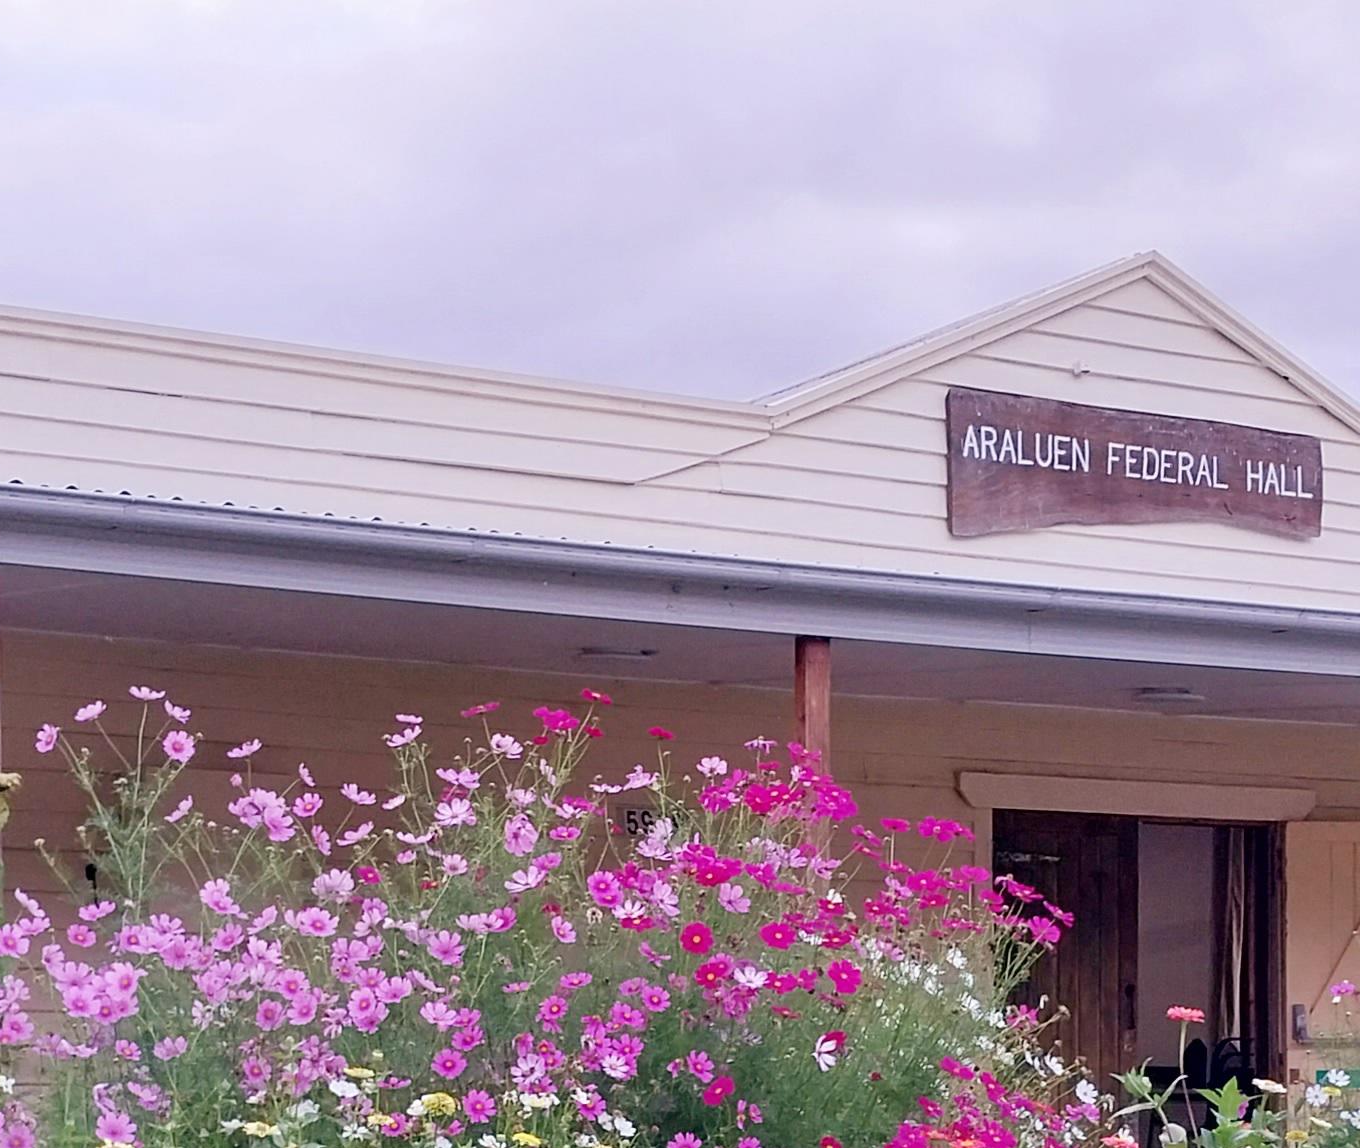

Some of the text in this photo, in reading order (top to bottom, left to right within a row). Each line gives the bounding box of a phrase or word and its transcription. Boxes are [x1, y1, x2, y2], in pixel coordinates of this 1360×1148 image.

[962, 425, 1314, 498] ARALUEN FEDERAL HALL
